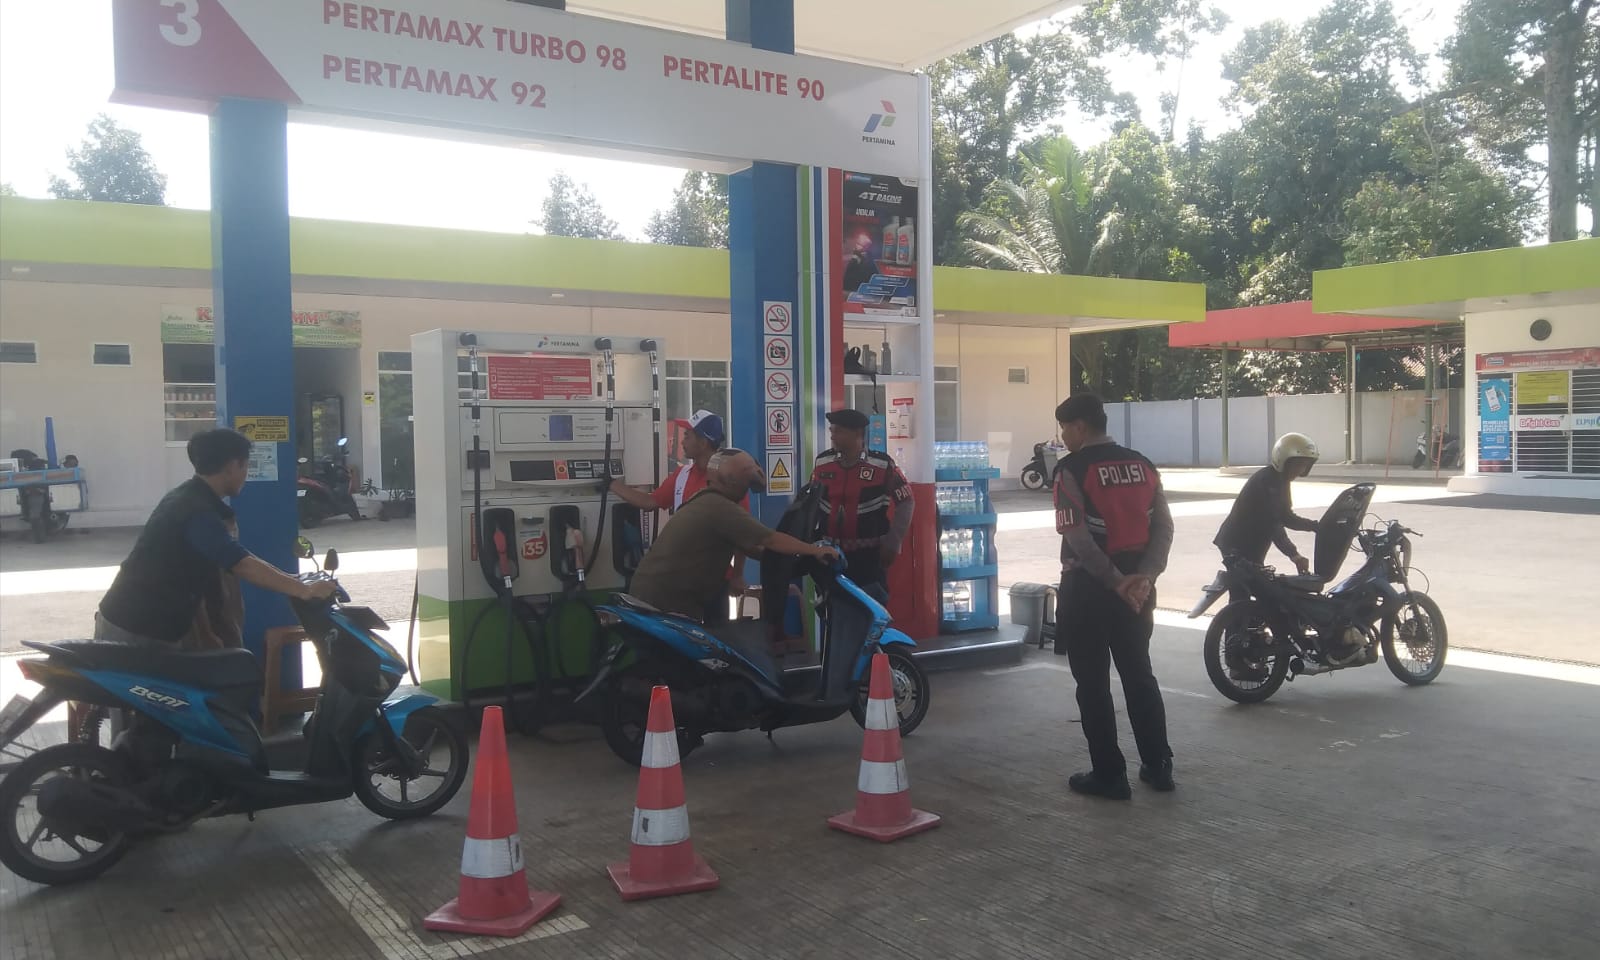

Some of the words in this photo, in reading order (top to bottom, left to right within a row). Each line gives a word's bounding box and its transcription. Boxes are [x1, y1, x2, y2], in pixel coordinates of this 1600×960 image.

[159, 0, 202, 47] 3
[323, 0, 485, 49] PERTAMAX
[492, 26, 586, 64] TURBO
[596, 45, 626, 71] 98
[323, 54, 498, 102] PERTAMAX
[511, 81, 547, 108] 92
[663, 55, 788, 96] PERTALITE
[797, 77, 825, 101] 90
[862, 135, 896, 145] PERTAMINA
[1098, 464, 1146, 486] POLISI
[522, 541, 545, 557] 135
